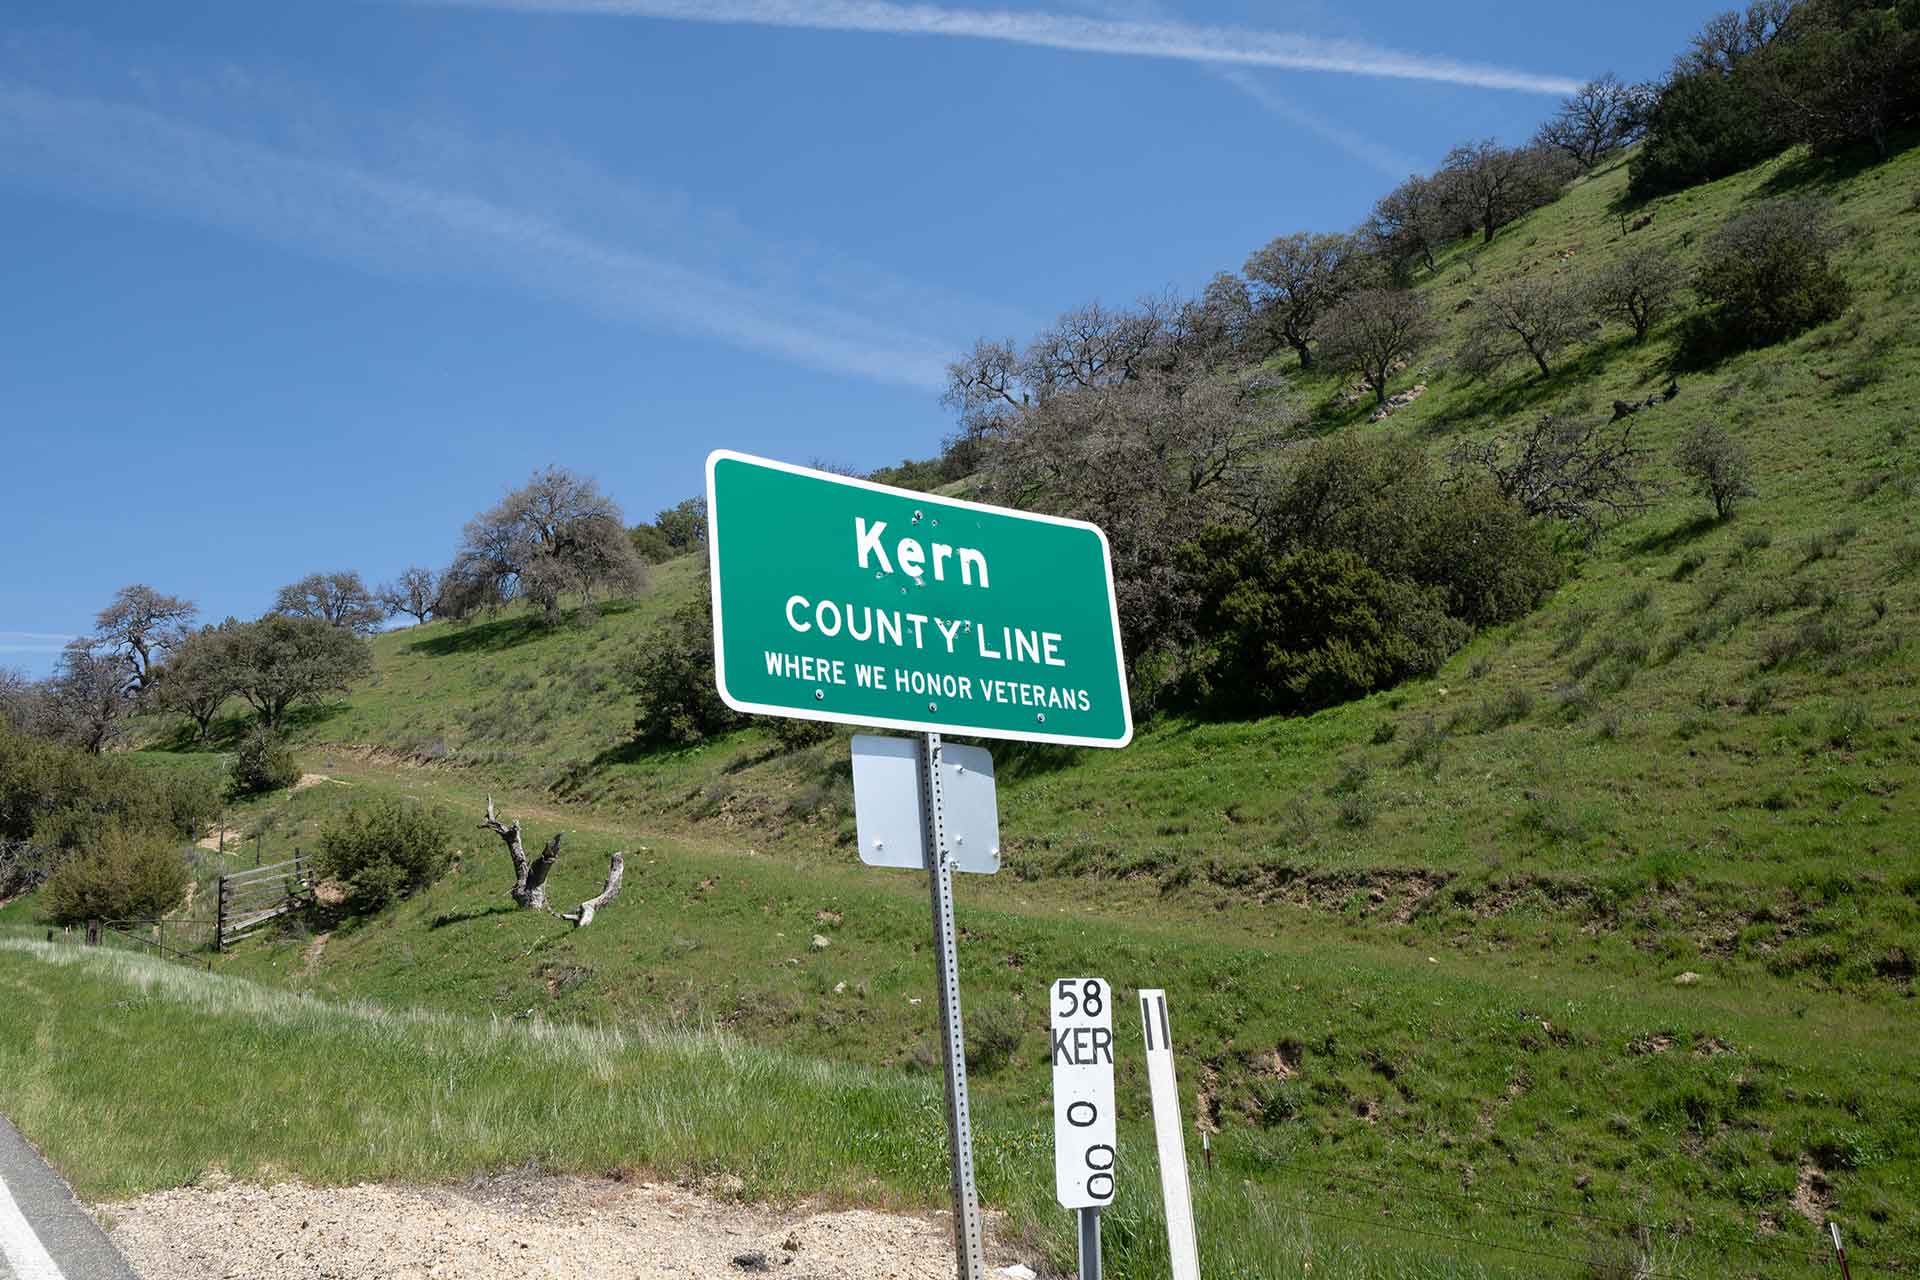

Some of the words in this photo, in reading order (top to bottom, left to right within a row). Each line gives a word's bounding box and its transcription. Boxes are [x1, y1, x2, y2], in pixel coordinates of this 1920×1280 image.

[854, 516, 990, 588] Kern
[785, 595, 961, 653] COUNTY
[977, 625, 1067, 666] LINE
[764, 651, 847, 686] WHERE
[855, 663, 888, 690] WE
[894, 666, 973, 700] HONOR
[980, 678, 1092, 712] VETERANS
[1058, 980, 1103, 1018] 58
[1052, 1027, 1113, 1066] KER
